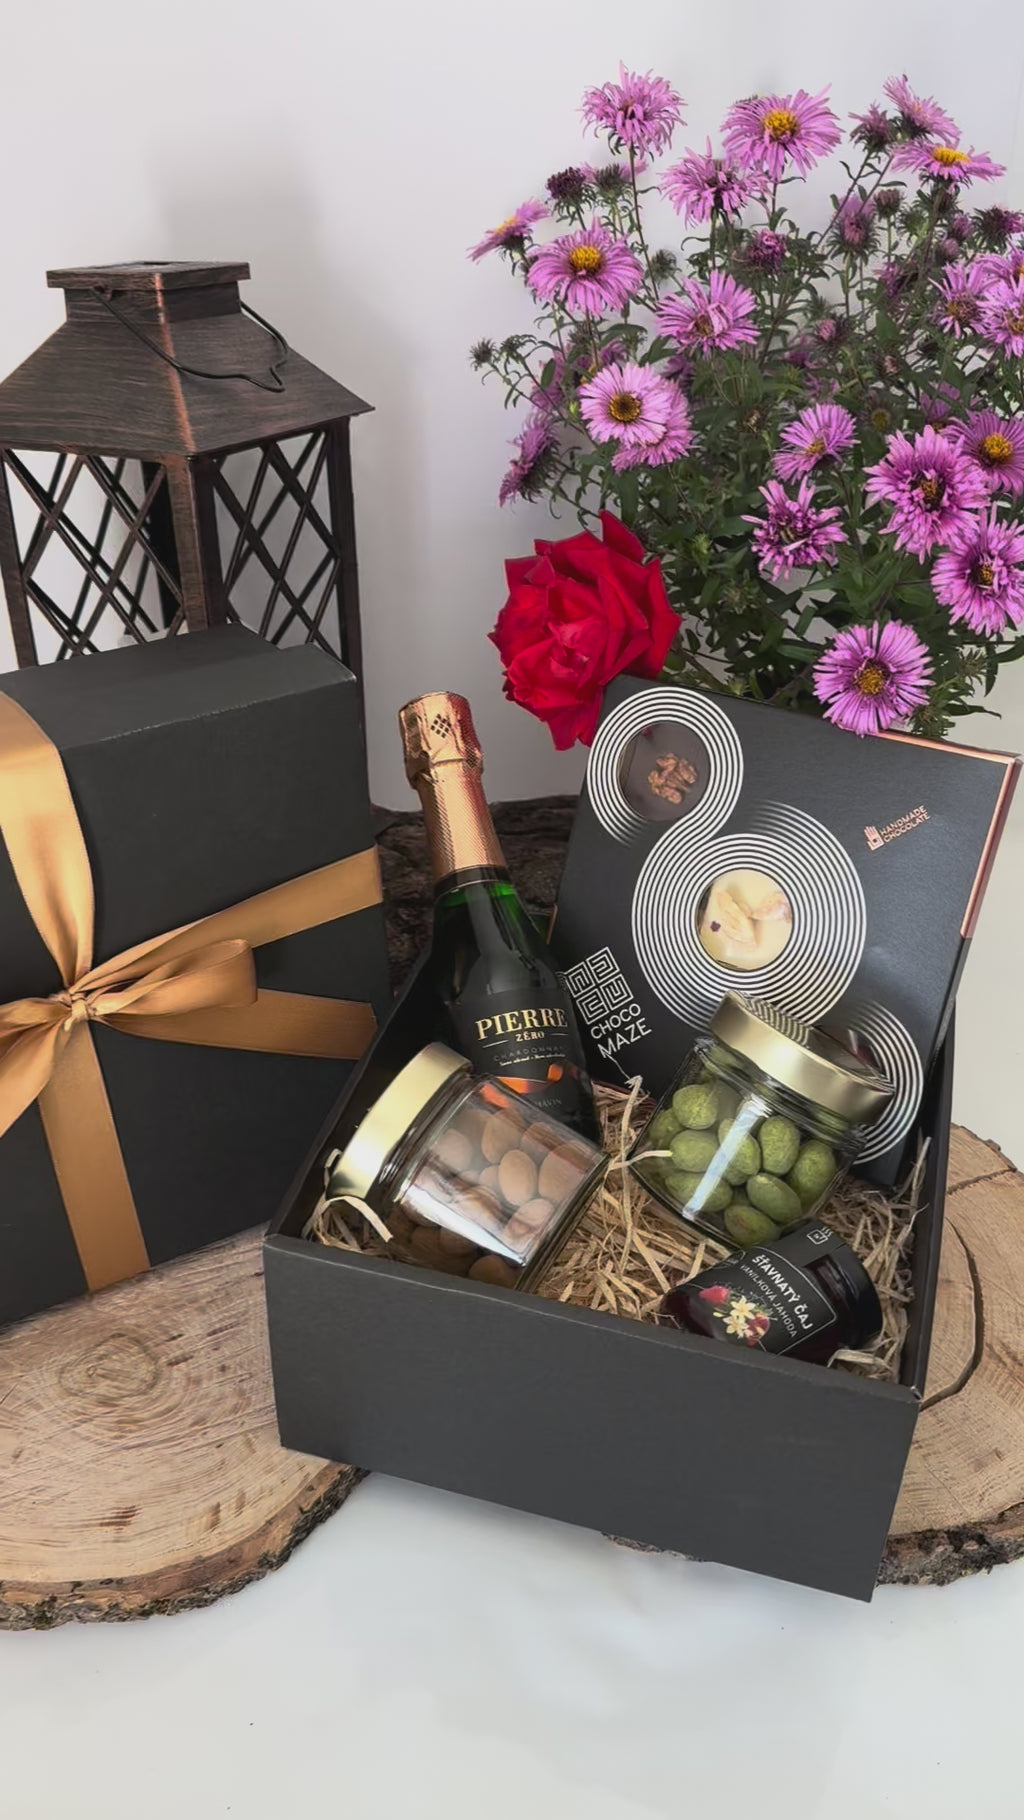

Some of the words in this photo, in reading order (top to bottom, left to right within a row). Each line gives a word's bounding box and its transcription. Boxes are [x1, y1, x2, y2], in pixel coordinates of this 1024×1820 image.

[880, 805, 927, 835] HANDMADE
[884, 812, 931, 842] CHOCOLATE
[475, 1008, 568, 1041] PIERRE
[515, 1031, 545, 1042] ZÉRO
[590, 1003, 641, 1039] CHOCO
[597, 1018, 652, 1058] MAZE
[752, 1254, 801, 1302] ŠŤAVNATÝ
[794, 1304, 814, 1330] ČAJ
[773, 1302, 798, 1338] JAHODA
